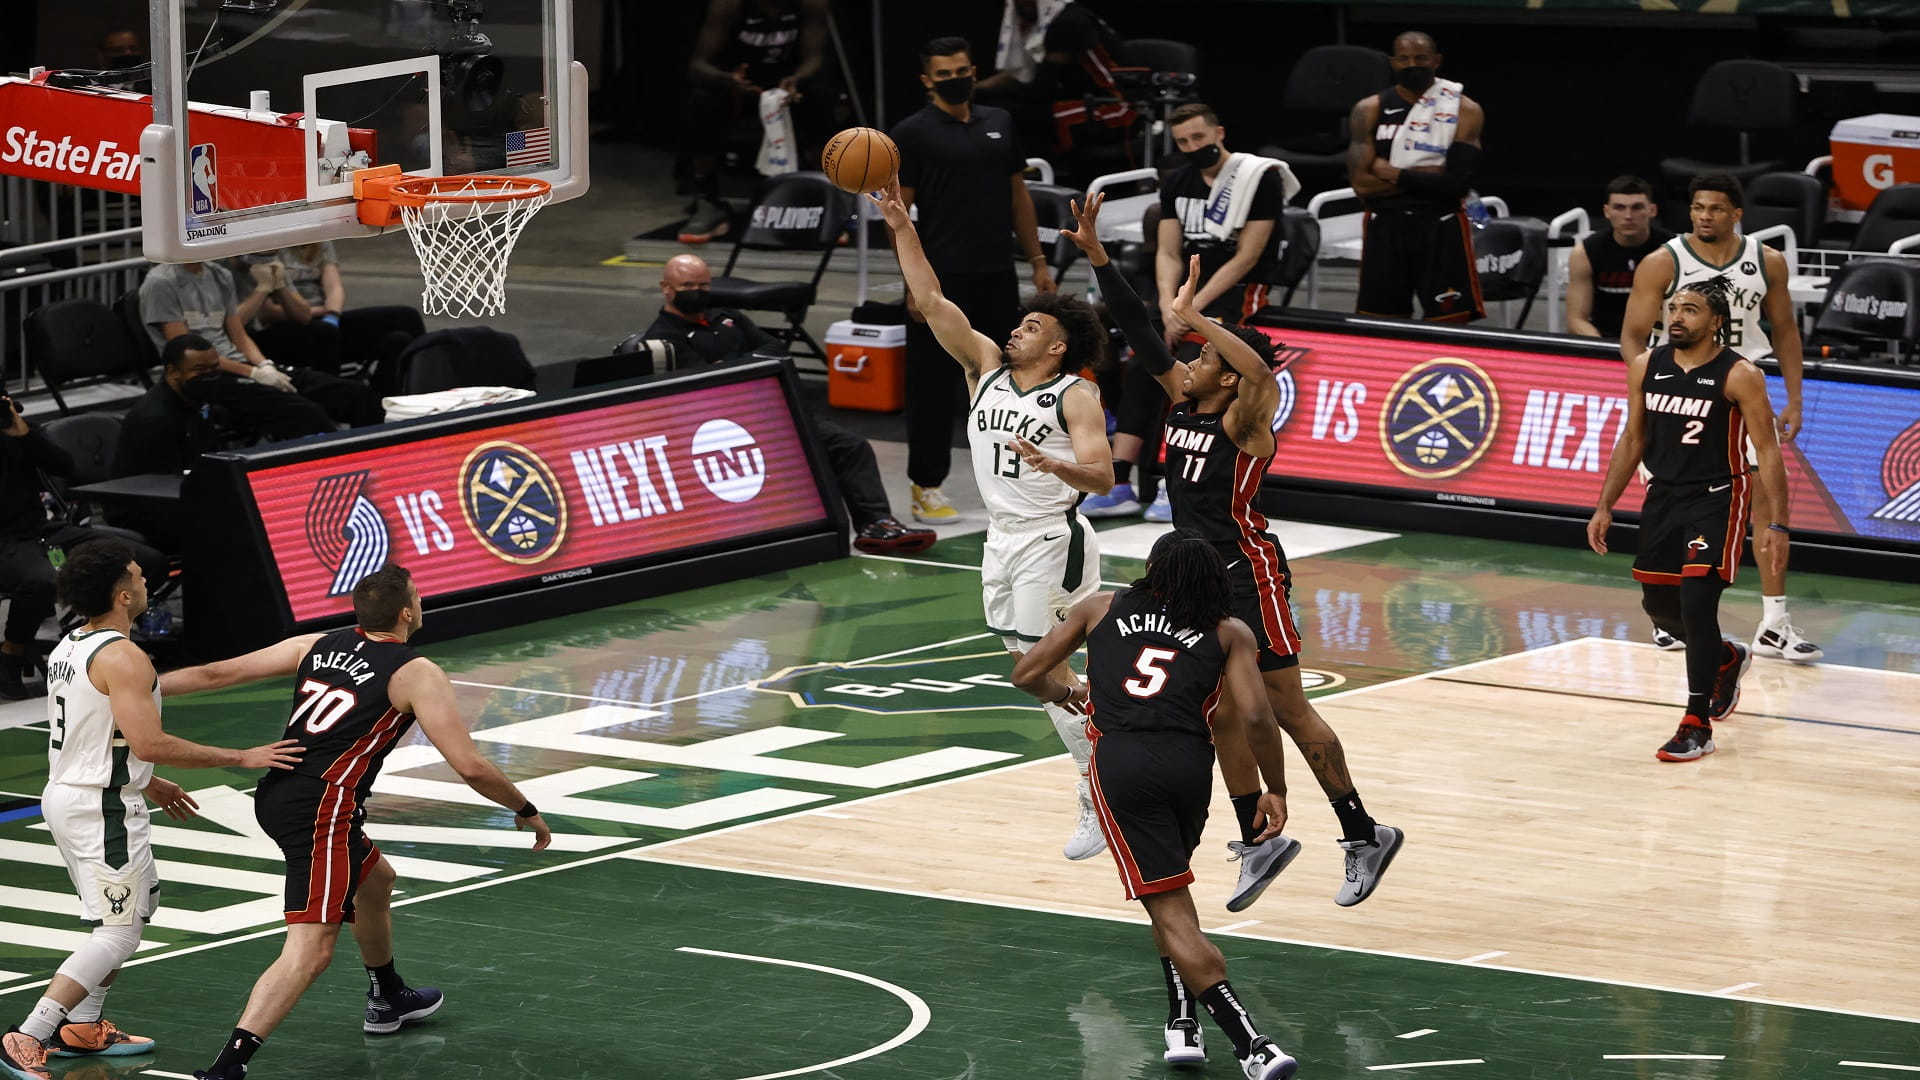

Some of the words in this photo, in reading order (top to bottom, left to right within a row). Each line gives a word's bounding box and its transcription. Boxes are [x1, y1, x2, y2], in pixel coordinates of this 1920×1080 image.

[90, 141, 141, 181] Far
[1863, 154, 1894, 190] G
[187, 225, 226, 241] SPALDING
[1312, 379, 1368, 443] VS
[1645, 392, 1713, 418] MIAMI
[977, 408, 1054, 446] BUCKS
[1681, 420, 1704, 445] 2
[993, 442, 1021, 479] 13
[1182, 454, 1207, 483] 11
[394, 489, 455, 556] VS
[570, 434, 685, 527] NEXT
[48, 661, 76, 686] BRYANT
[312, 651, 376, 686] BJELICA
[1122, 645, 1179, 699] 5
[51, 695, 66, 751] 3
[288, 677, 358, 736] 70
